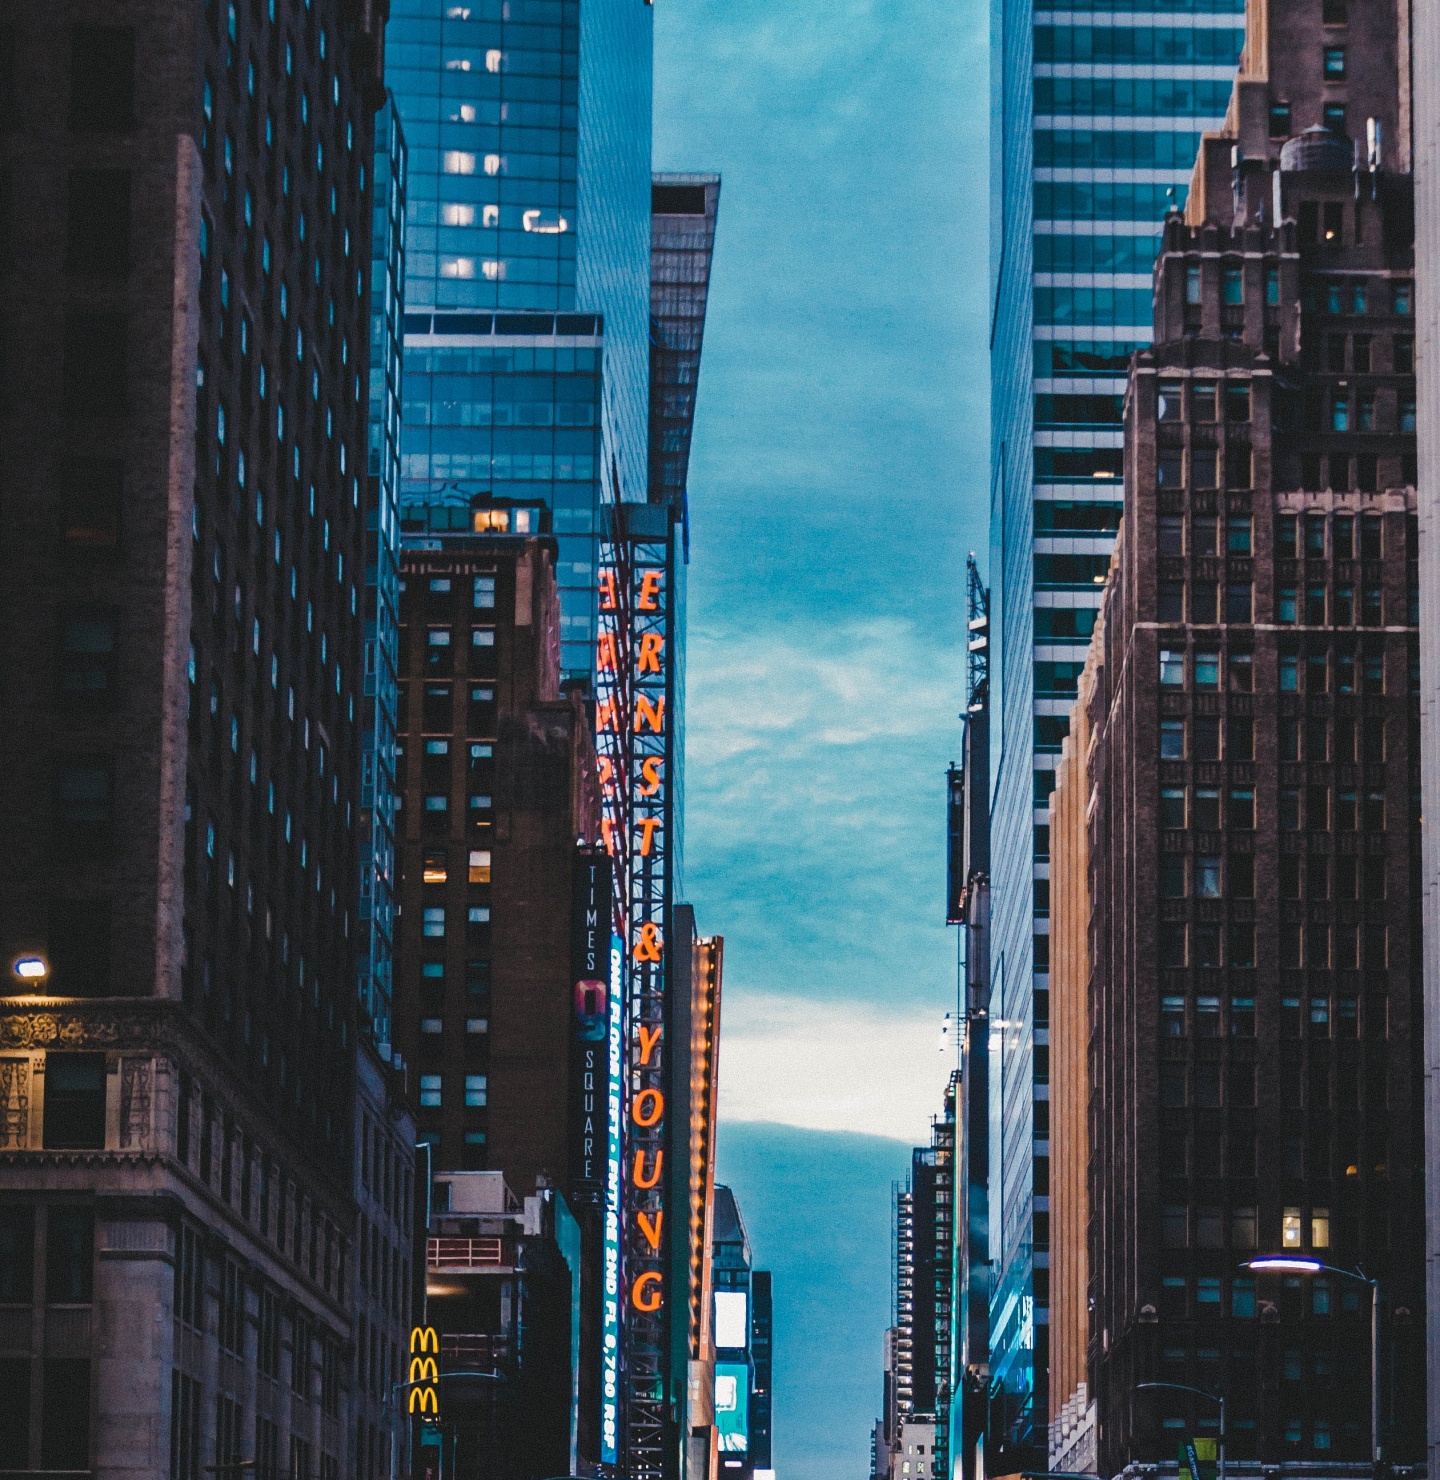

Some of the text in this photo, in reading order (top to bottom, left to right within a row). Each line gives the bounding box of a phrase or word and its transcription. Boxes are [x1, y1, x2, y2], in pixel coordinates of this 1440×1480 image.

[586, 865, 598, 971] TIMES
[632, 570, 665, 1312] ERNST & YOUNG
[610, 948, 622, 999] ONE
[609, 1001, 621, 1078] FLOOR
[584, 1050, 594, 1178] SQUARE
[608, 1081, 620, 1140] LEFT
[606, 1158, 619, 1243] ENTIRE
[605, 1246, 618, 1296] 2ND
[604, 1300, 617, 1328] FL
[604, 1403, 616, 1450] RSF
